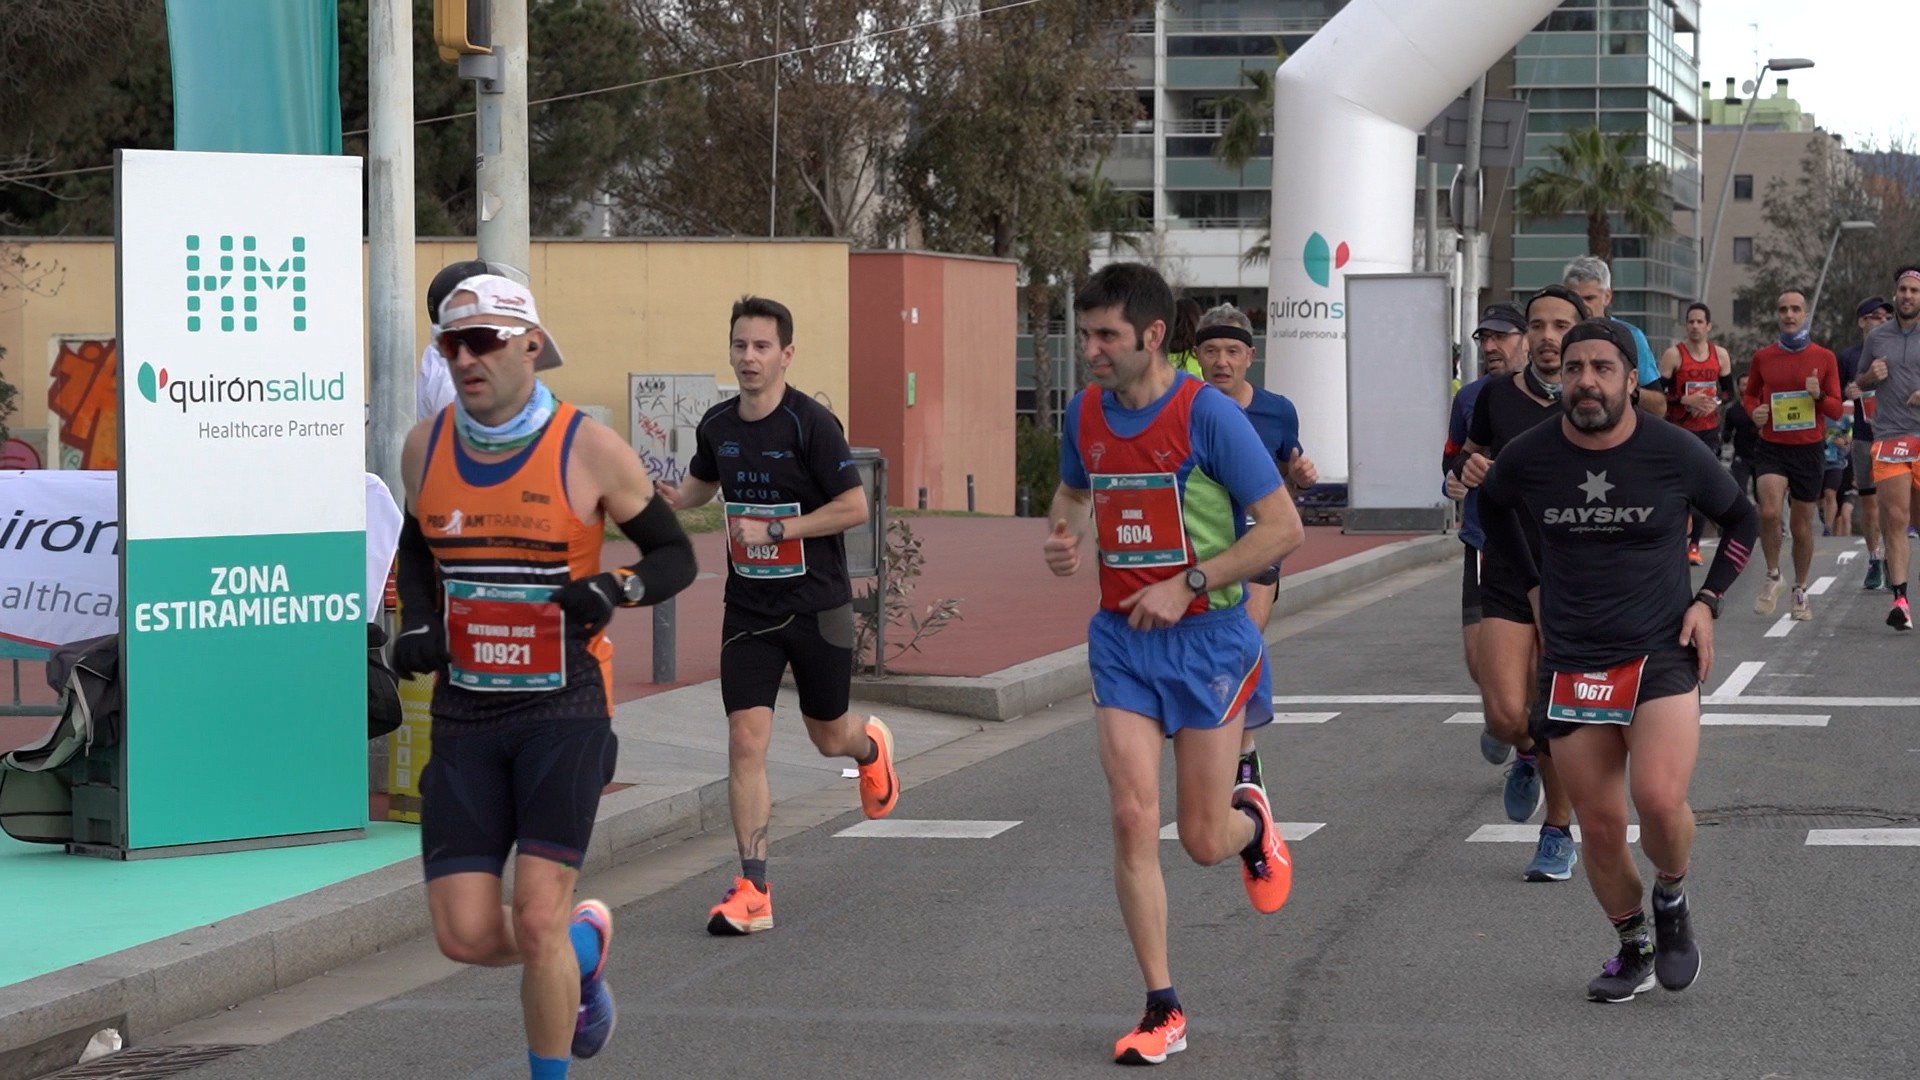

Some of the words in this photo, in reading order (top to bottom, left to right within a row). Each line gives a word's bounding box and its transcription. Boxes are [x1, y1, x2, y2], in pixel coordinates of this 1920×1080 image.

[1299, 330, 1338, 340] persona
[168, 371, 345, 413] quirónsalud
[198, 420, 284, 439] Healthcare
[288, 419, 345, 438] Partner
[736, 471, 771, 484] RUN
[733, 488, 781, 500] YOUR
[1543, 506, 1655, 525] SAYSKY
[1115, 524, 1153, 544] 1604
[210, 564, 290, 596] ZONA
[1, 581, 119, 618] althca
[135, 592, 361, 632] ESTIRAMIENTOS
[466, 623, 510, 638] ANTONIO
[472, 641, 532, 665] 10921
